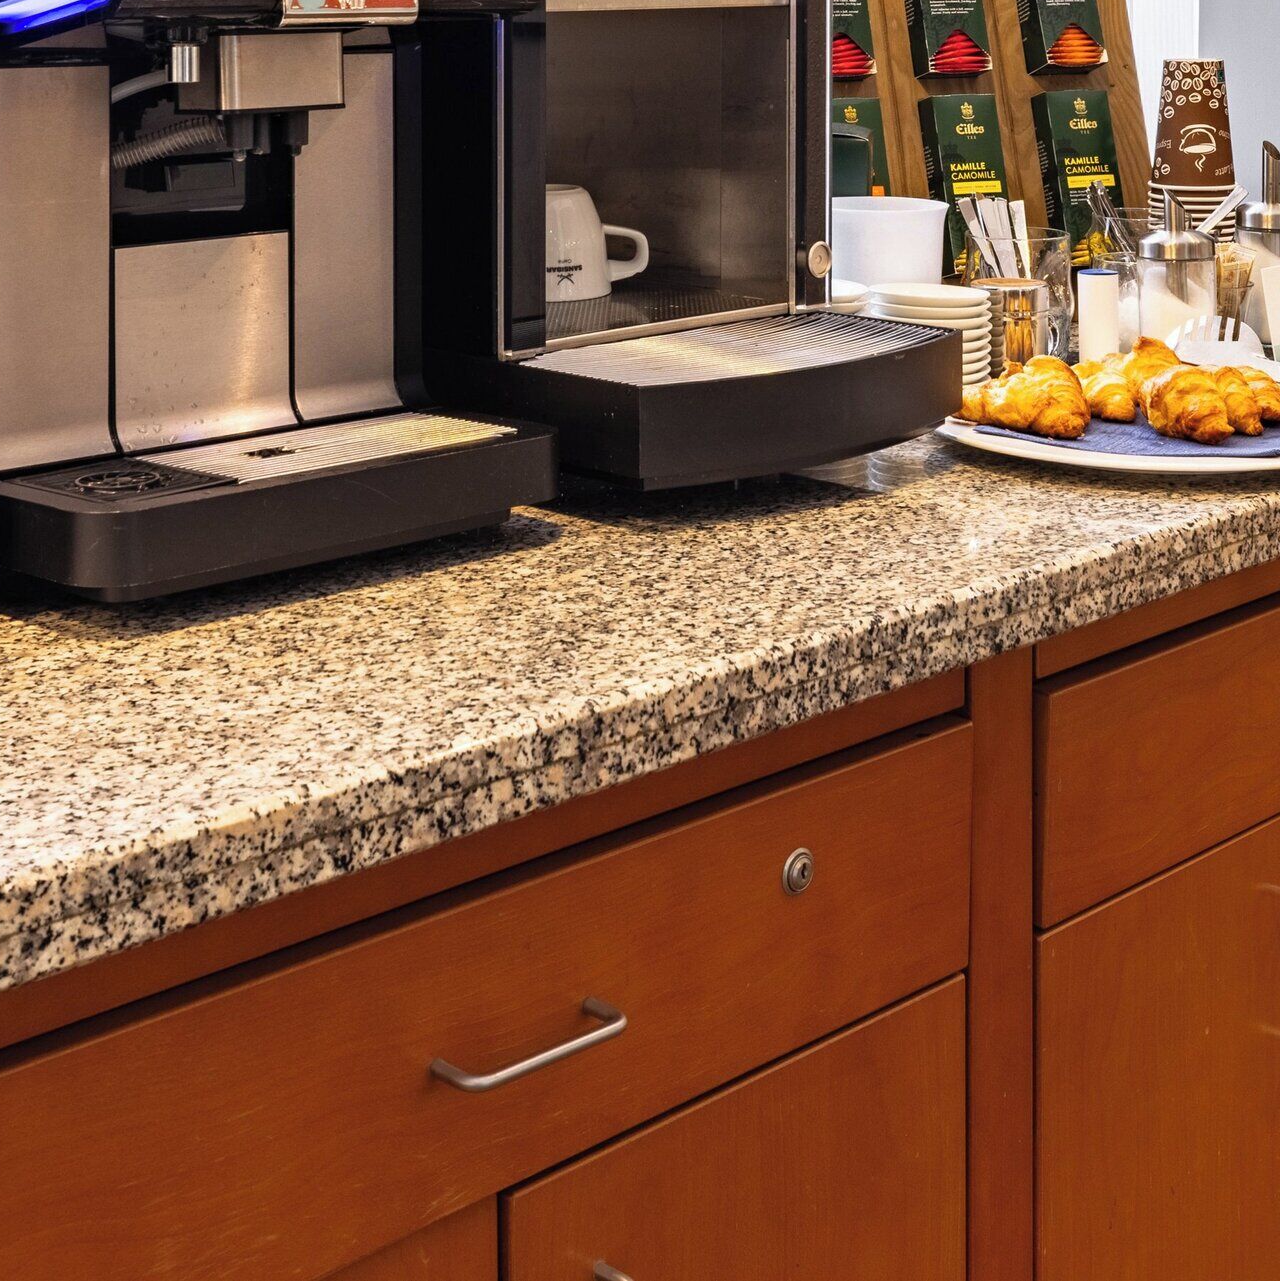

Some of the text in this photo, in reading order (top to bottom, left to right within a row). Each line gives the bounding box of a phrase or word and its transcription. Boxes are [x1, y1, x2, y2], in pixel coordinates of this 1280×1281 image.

[955, 123, 985, 135] Eilles
[1069, 118, 1098, 130] Eilles
[1155, 139, 1172, 149] Espr
[1064, 156, 1100, 166] KAMILLE
[950, 162, 986, 171] KAMILLE
[1065, 164, 1110, 174] CAMOMILE
[951, 170, 996, 181] CAMOMILE
